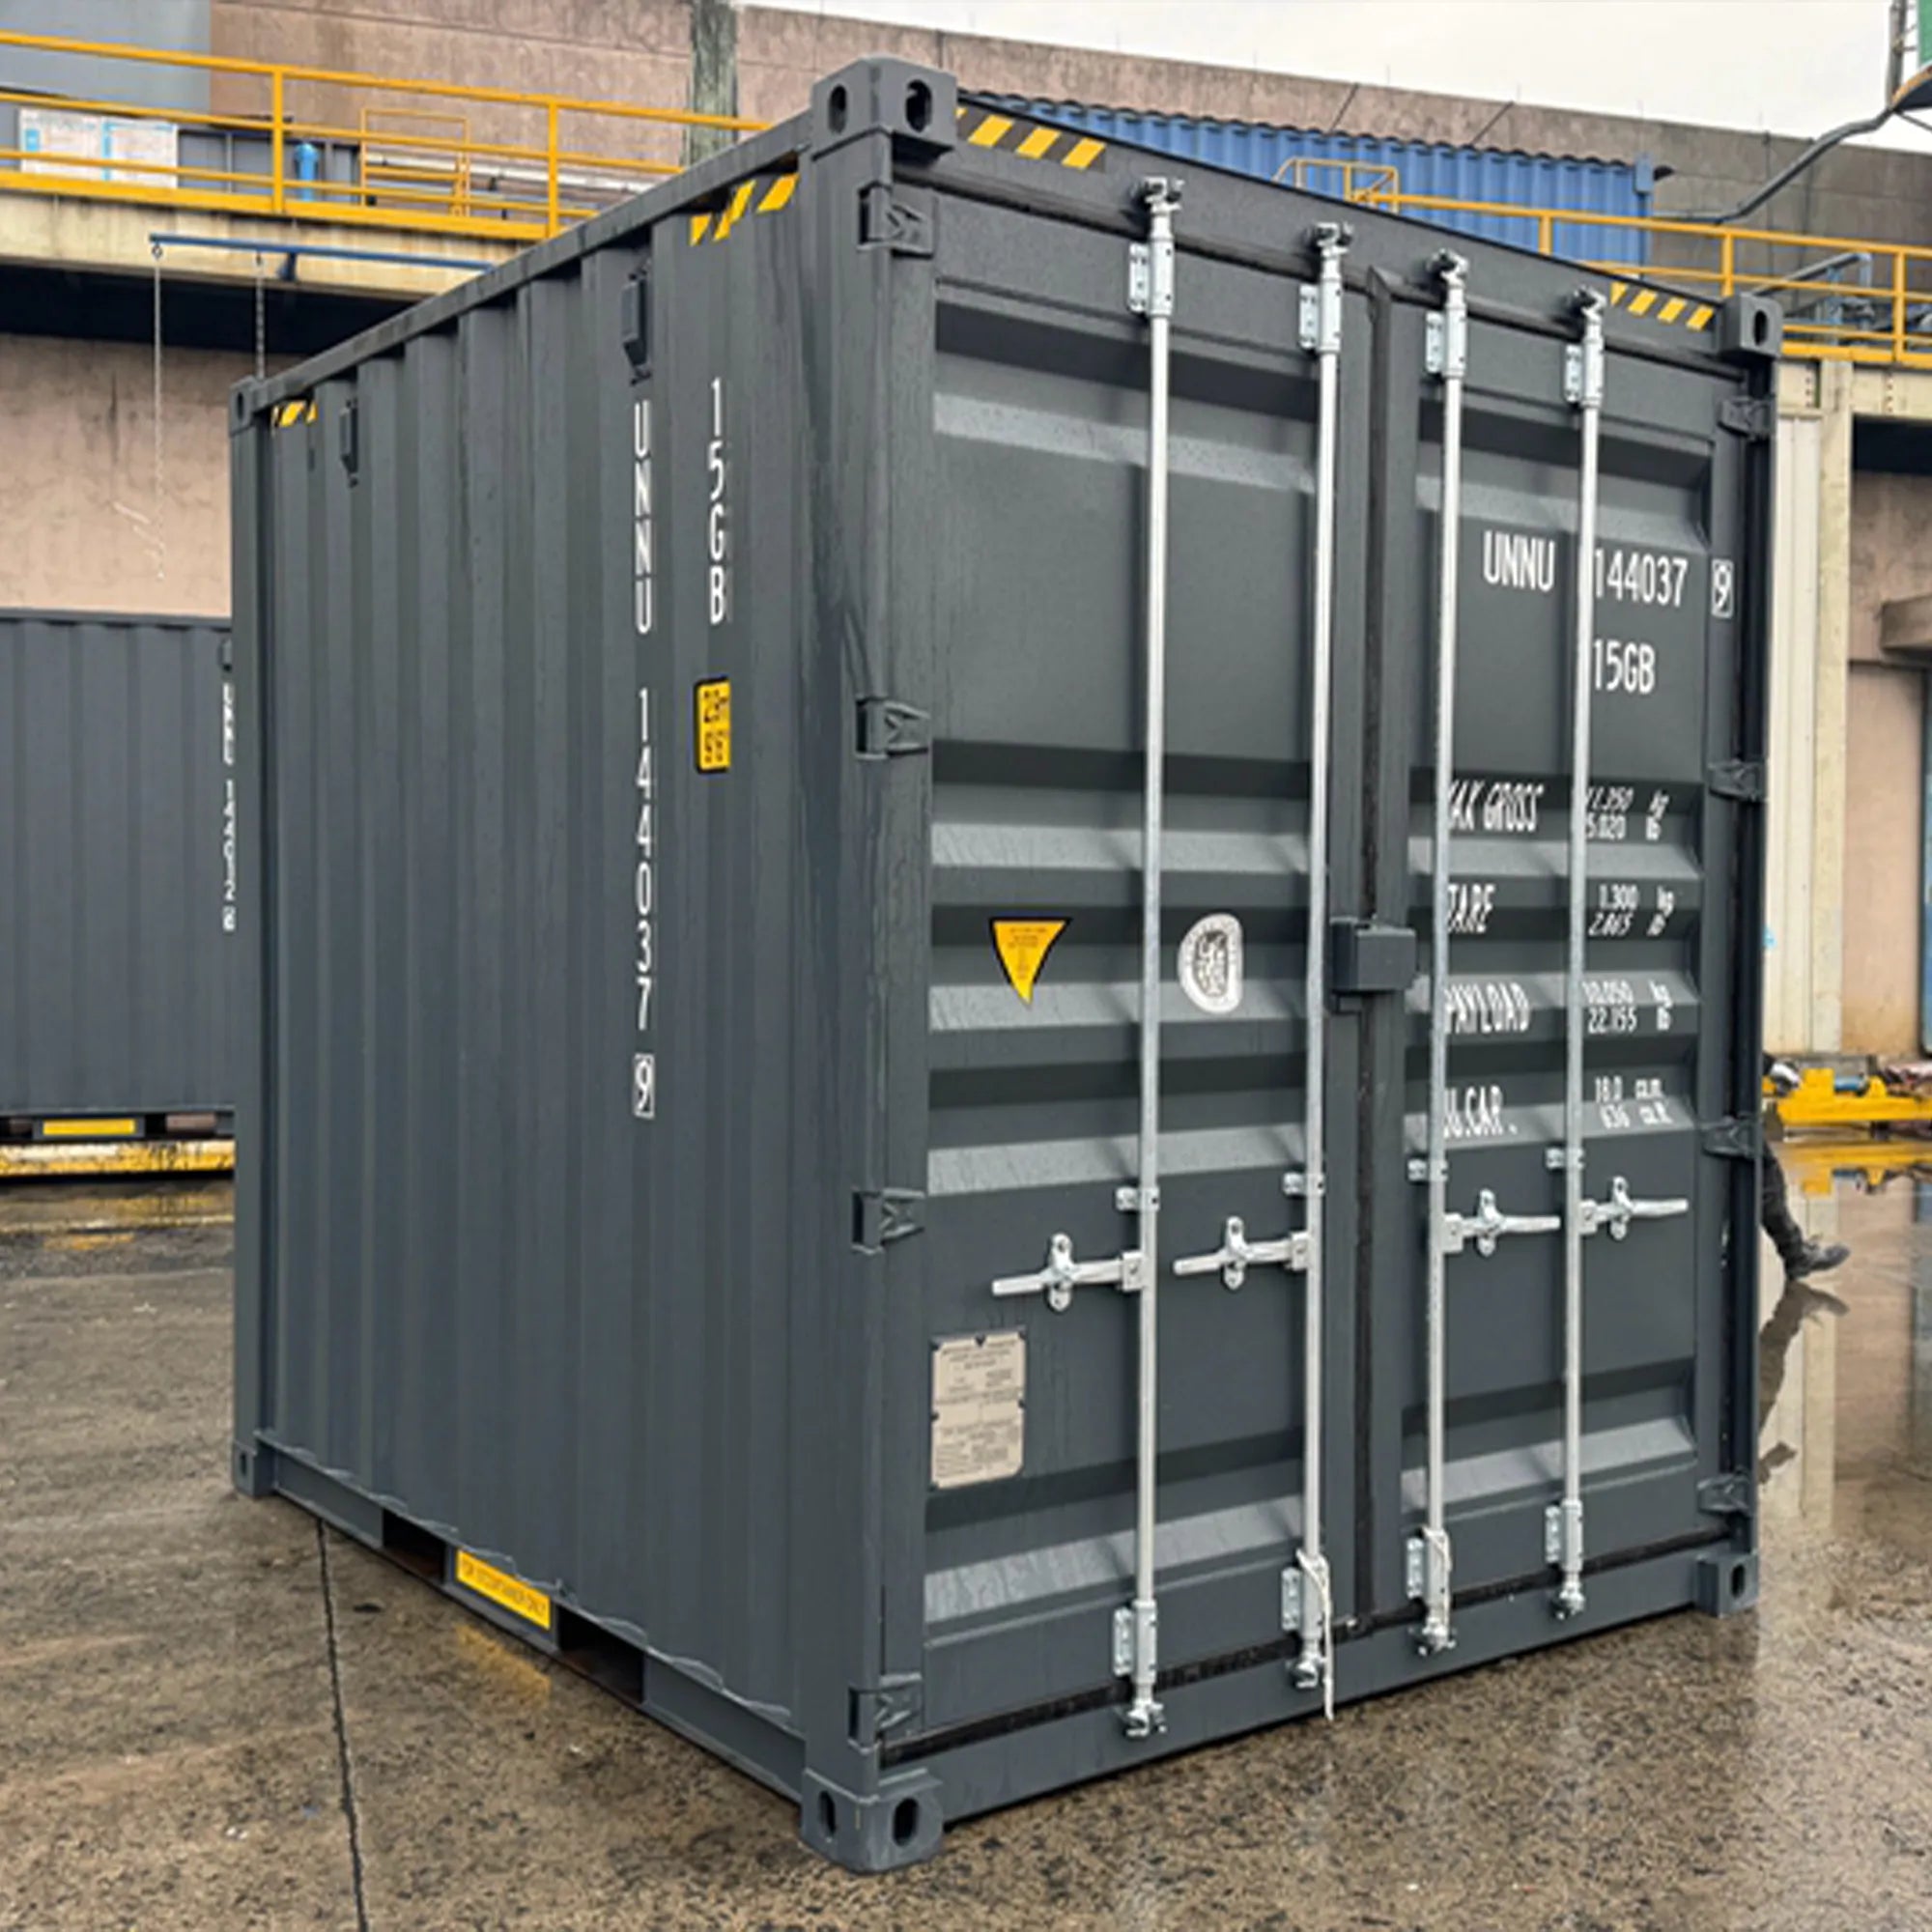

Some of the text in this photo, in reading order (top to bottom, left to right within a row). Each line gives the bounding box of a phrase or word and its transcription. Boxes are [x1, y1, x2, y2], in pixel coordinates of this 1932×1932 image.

[708, 377, 725, 625] 15GB
[1483, 530, 1733, 617] UNNU 144037 9
[1594, 639, 1656, 694] 15GB
[634, 399, 655, 1119] UNNU 144037 9
[1484, 781, 1544, 832] GROSS
[1447, 882, 1496, 934] TARE
[1657, 884, 1674, 918] kg
